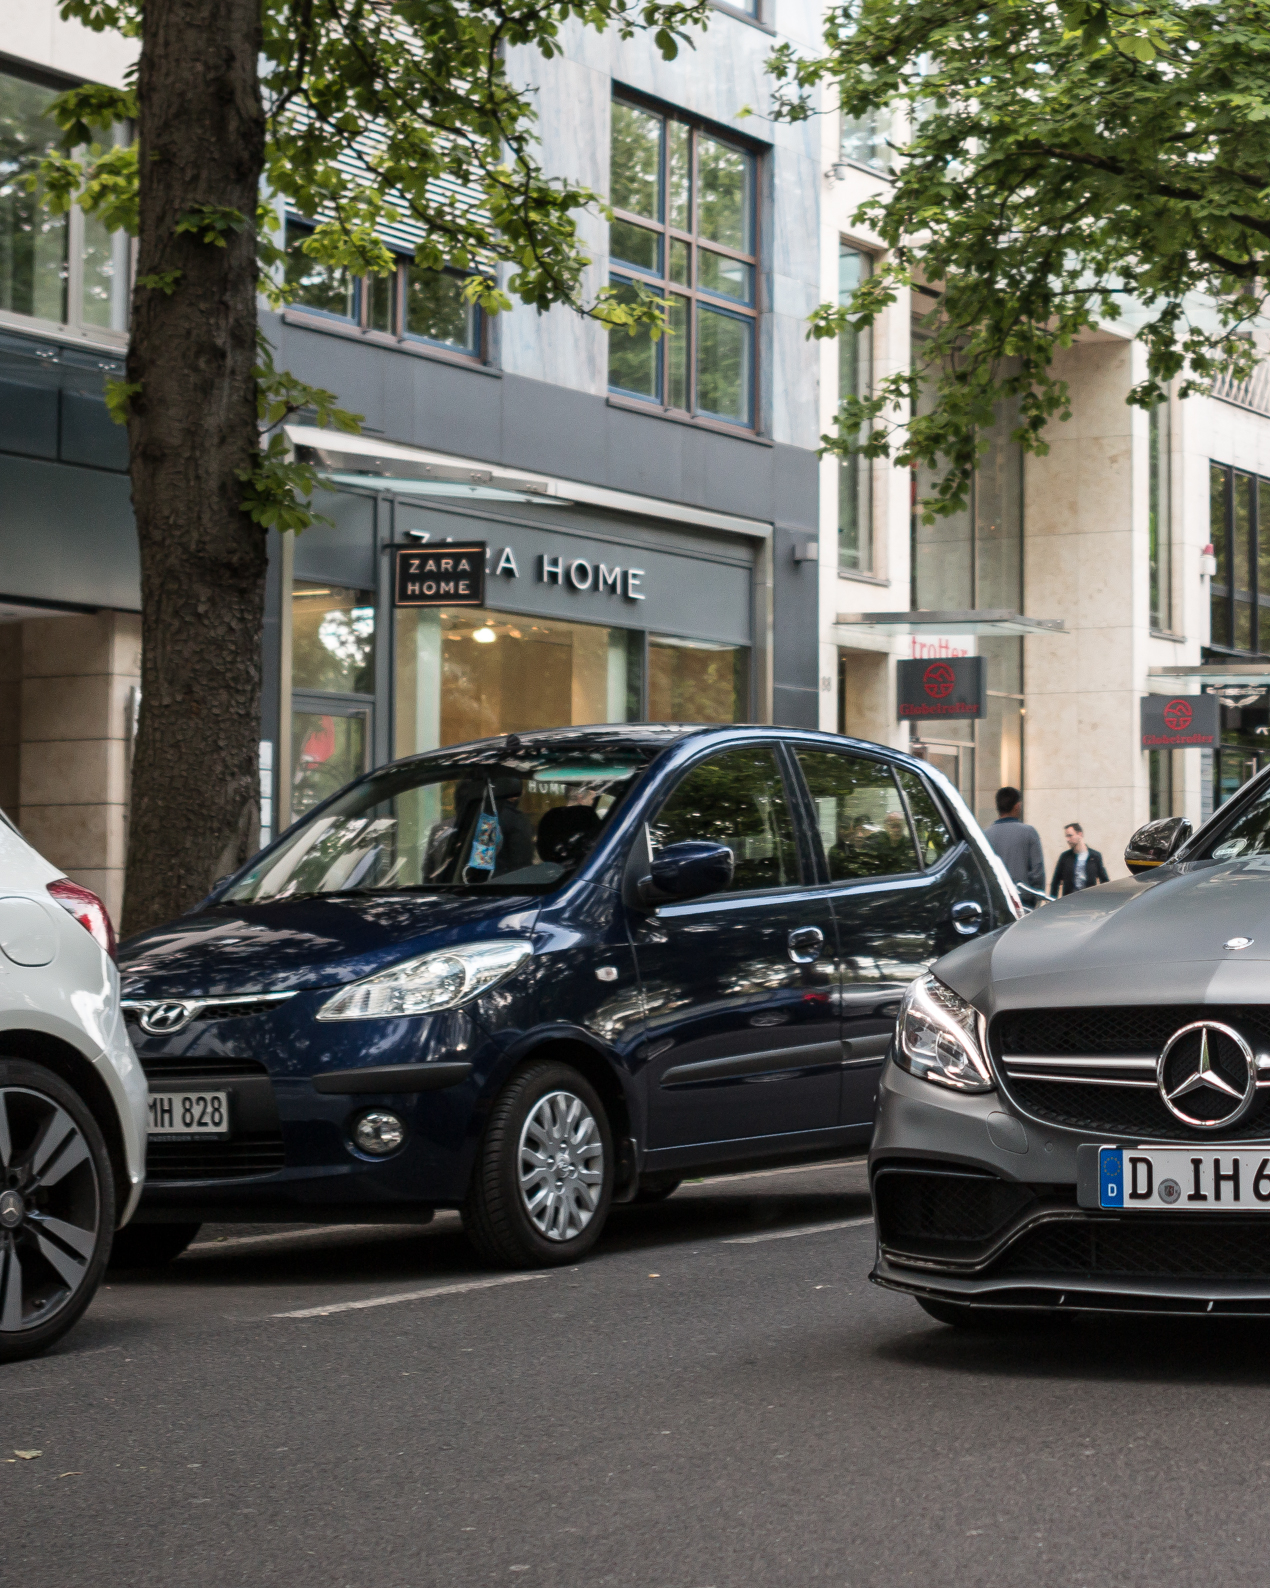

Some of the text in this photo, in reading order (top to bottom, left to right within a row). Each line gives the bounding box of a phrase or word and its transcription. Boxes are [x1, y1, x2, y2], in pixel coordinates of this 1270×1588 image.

[408, 558, 471, 573] ZARA
[541, 553, 646, 600] HOME
[406, 580, 471, 595] HOME
[899, 702, 980, 715] Globetrotter
[1142, 733, 1214, 746] Globetrotter
[181, 1095, 224, 1129] 828
[1128, 1156, 1154, 1201] D
[1107, 1183, 1118, 1198] D
